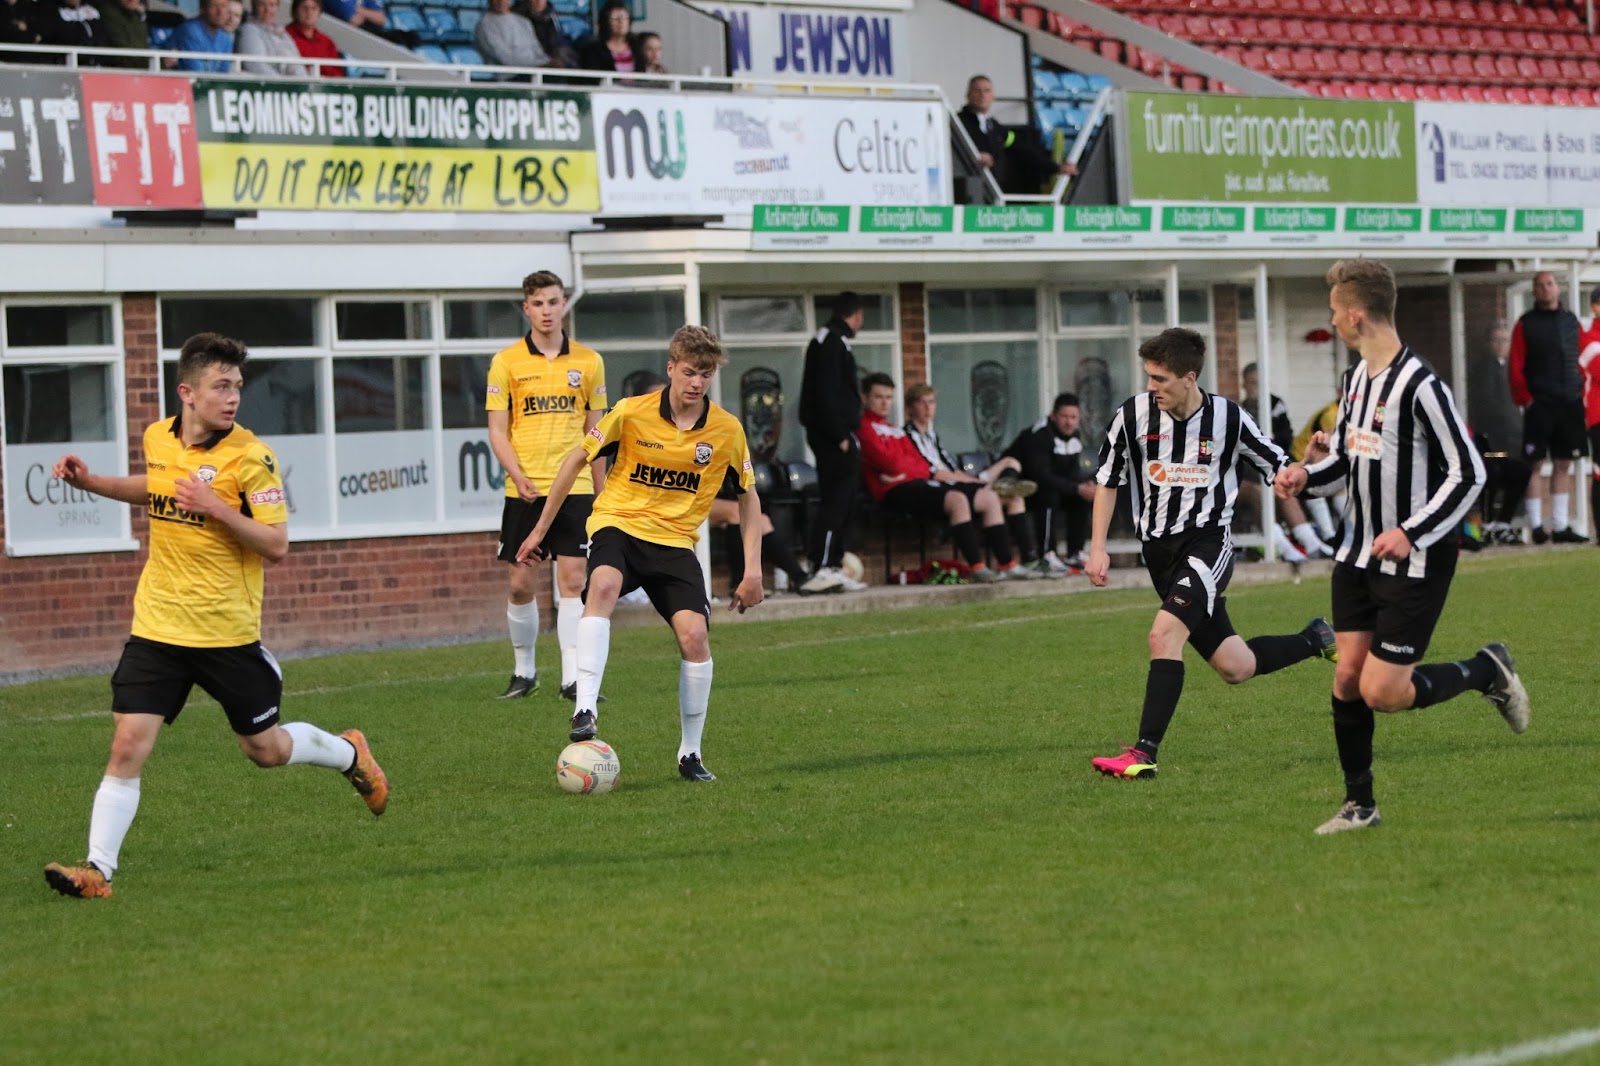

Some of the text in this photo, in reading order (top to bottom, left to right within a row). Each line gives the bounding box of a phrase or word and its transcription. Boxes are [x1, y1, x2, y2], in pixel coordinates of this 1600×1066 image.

[774, 12, 893, 76] JEWSON
[208, 89, 581, 141] LEOMINSTER BUILDING SUPPLIES
[1143, 99, 1402, 168] furnitureimporters.co.uk
[91, 101, 190, 187] FIT
[834, 117, 919, 174] Celtic
[233, 154, 570, 209] DO IT FOR LESS AT LBS
[523, 395, 577, 412] JEWSON
[636, 439, 664, 450] macron
[339, 458, 429, 497] coceaunut
[630, 463, 701, 490] JEWSON
[57, 507, 101, 527] SPRING
[593, 761, 619, 773] mitre
